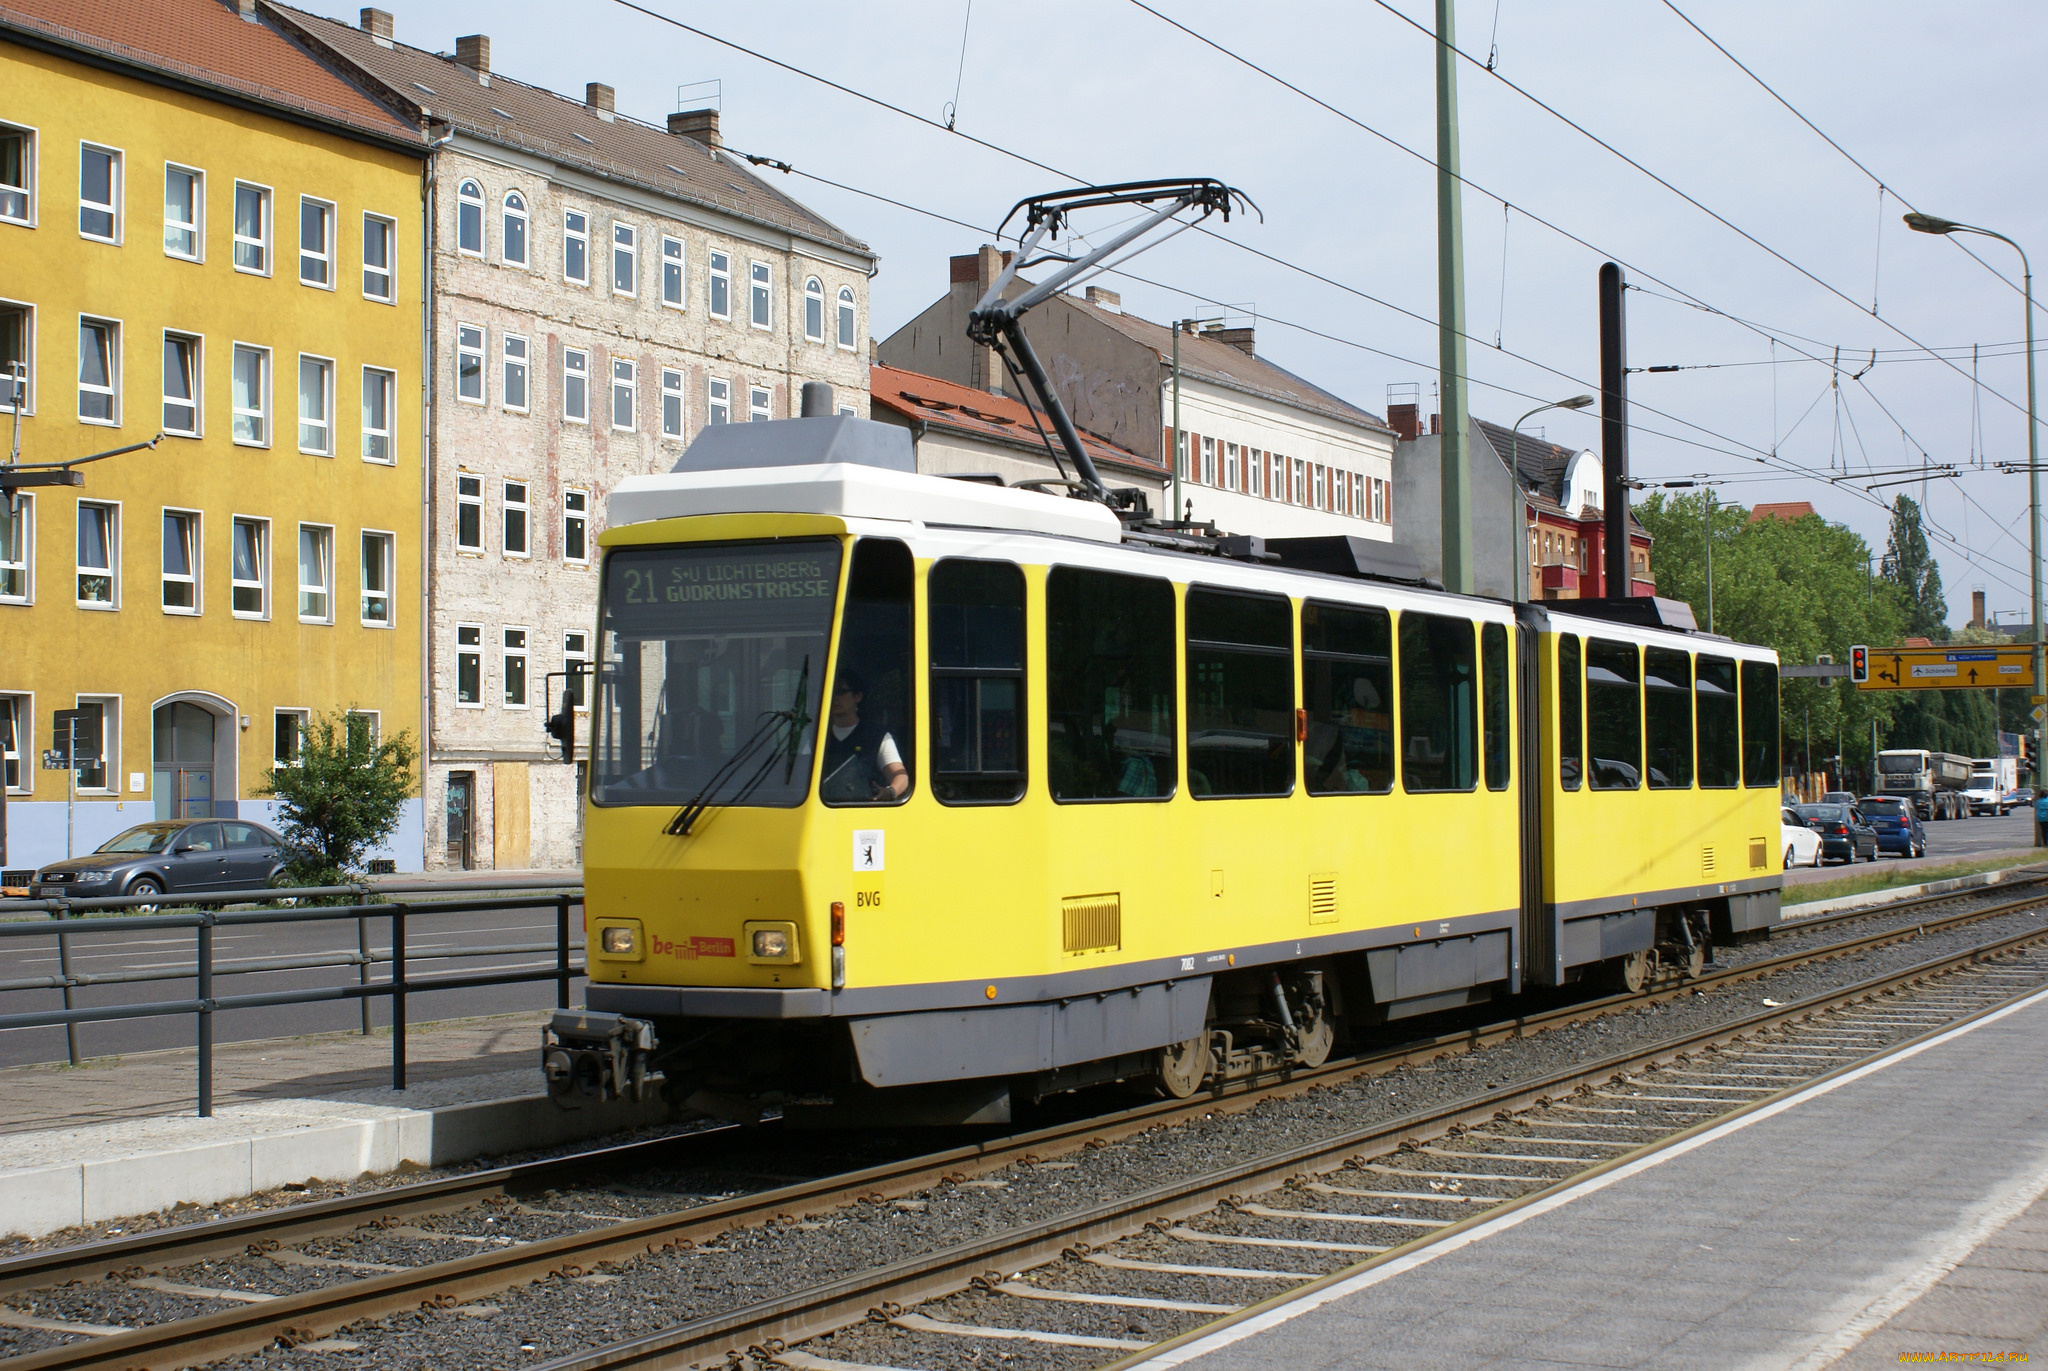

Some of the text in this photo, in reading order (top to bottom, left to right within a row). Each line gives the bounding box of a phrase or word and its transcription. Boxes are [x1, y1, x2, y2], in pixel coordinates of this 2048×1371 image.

[672, 561, 821, 583] S+U LICHTENBERG
[623, 568, 659, 604] 21
[666, 580, 830, 602] GUDRUNSTRASSE
[857, 891, 881, 907] BVG
[652, 934, 732, 955] be Berlin
[1181, 957, 1194, 971] 7082
